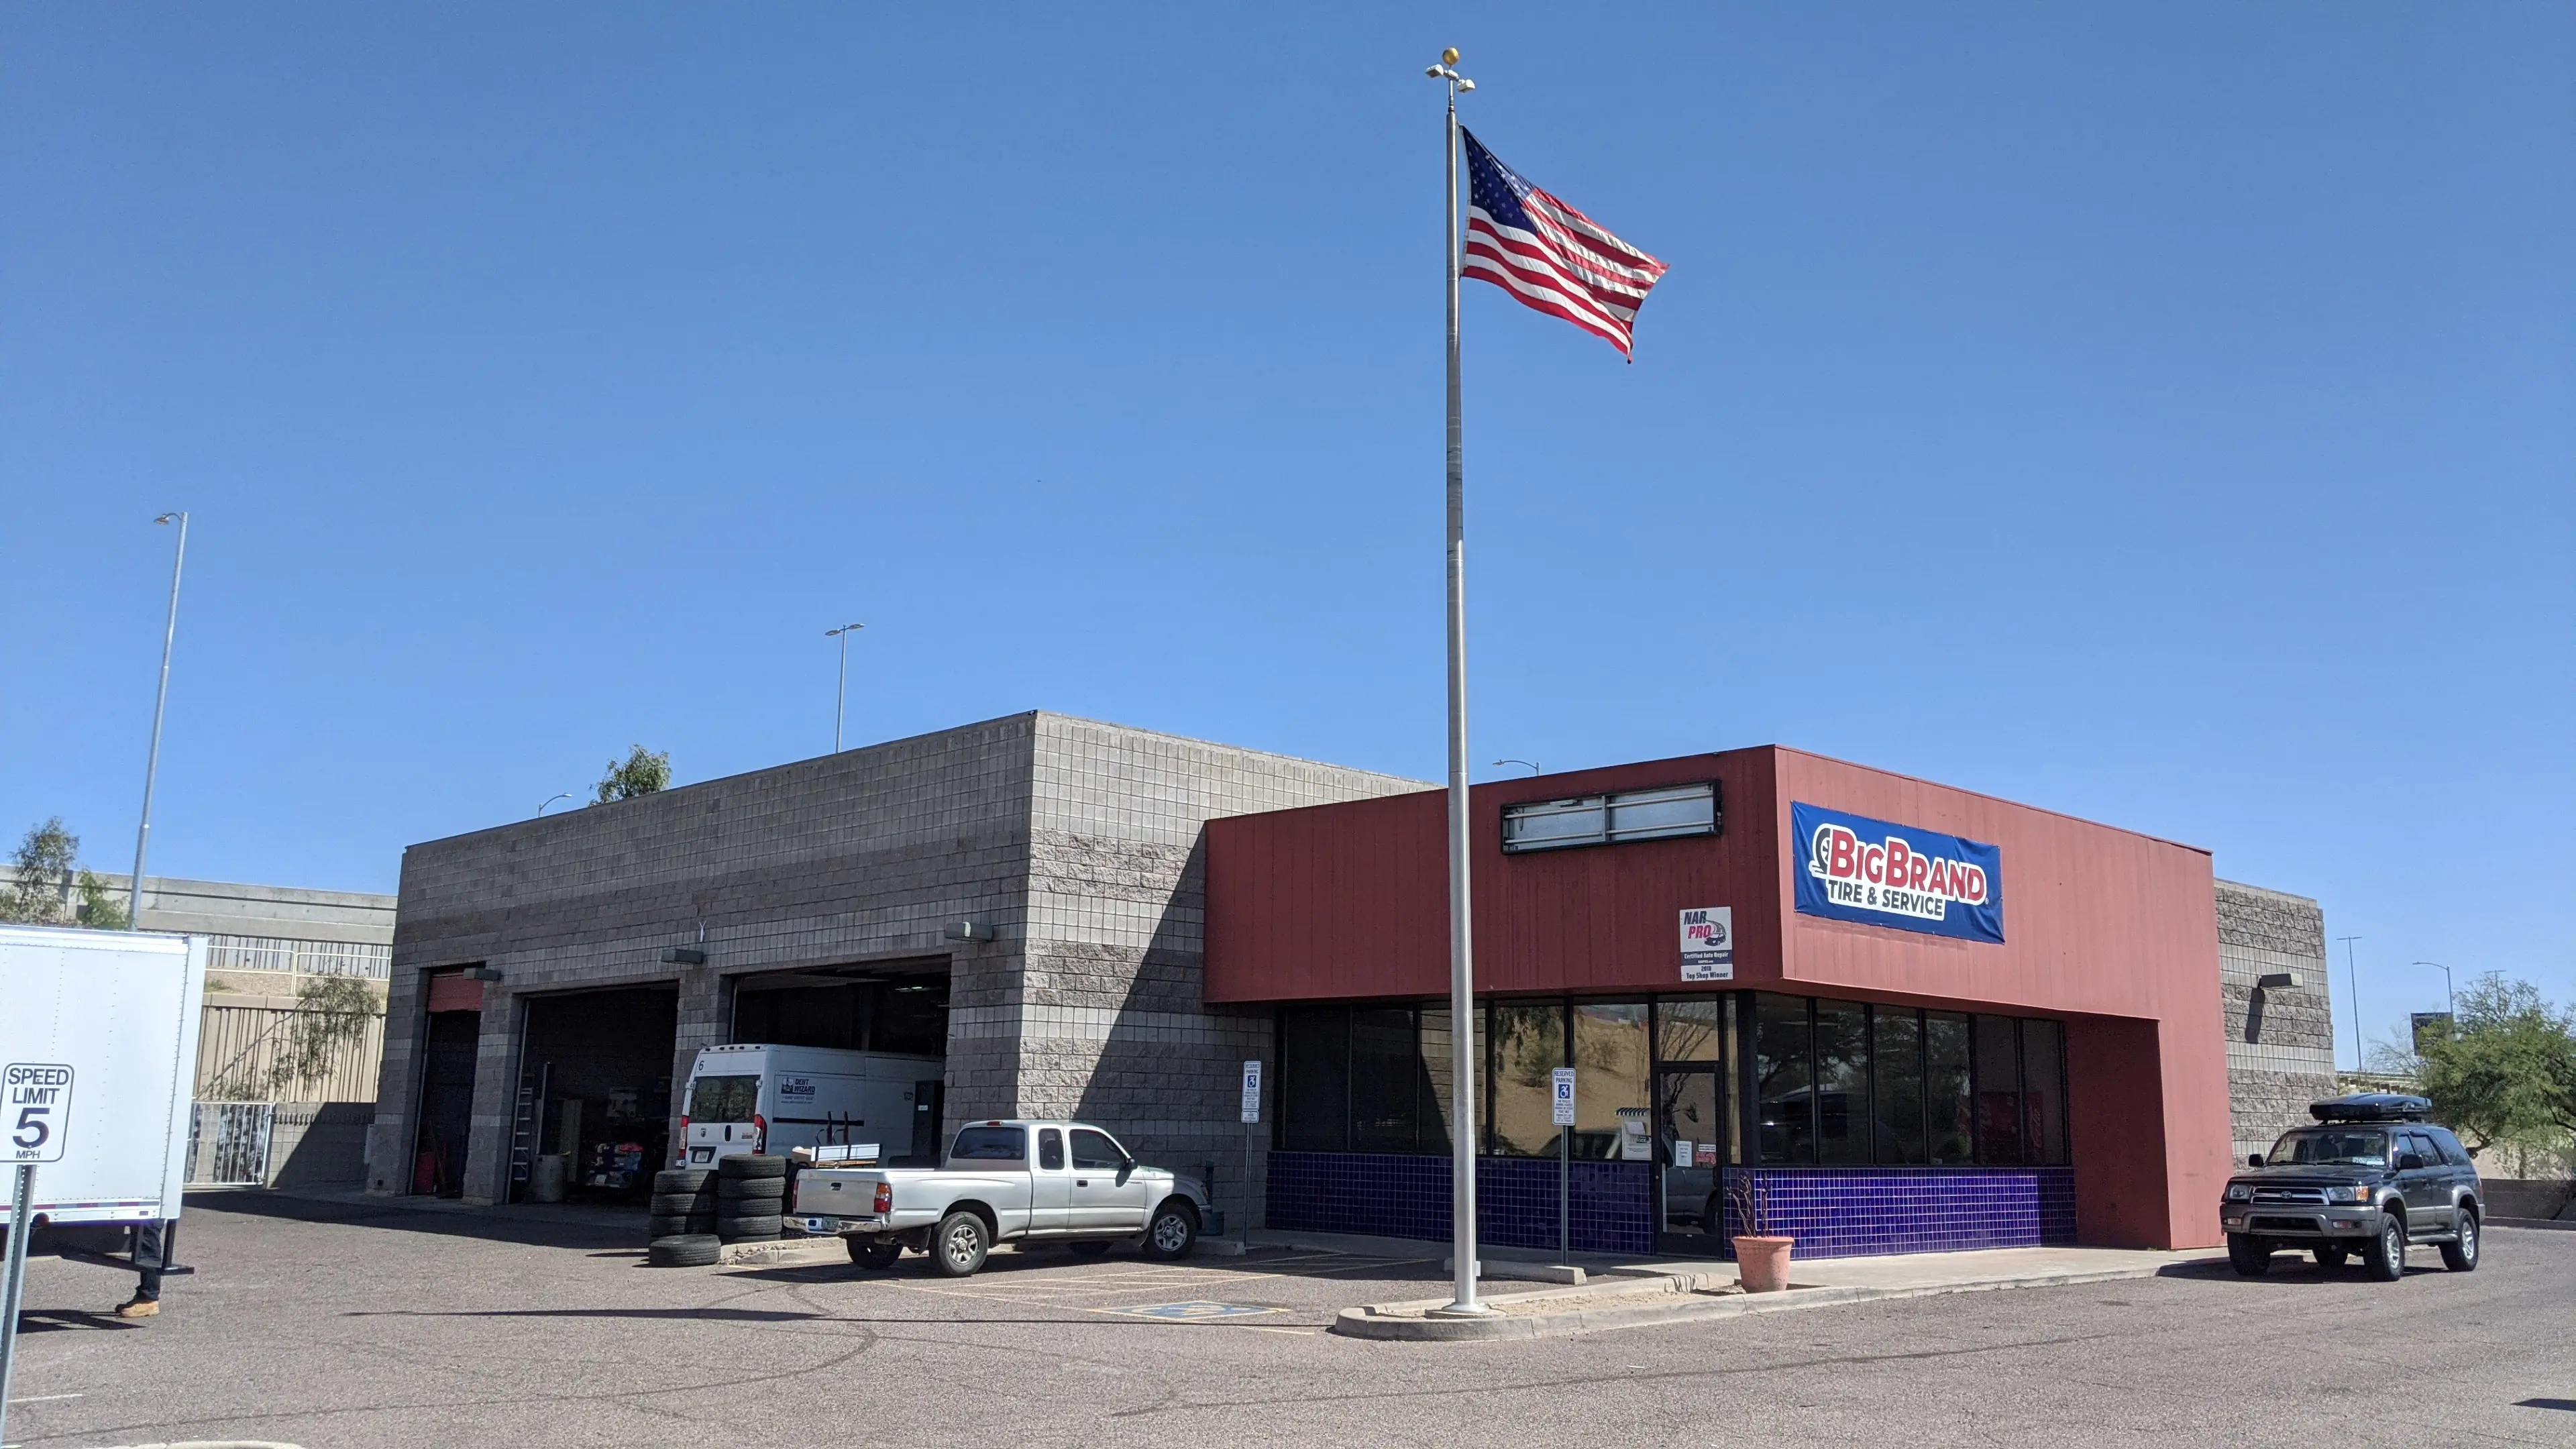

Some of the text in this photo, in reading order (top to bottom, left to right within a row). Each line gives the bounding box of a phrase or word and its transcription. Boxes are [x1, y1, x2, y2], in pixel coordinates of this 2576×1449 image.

[1828, 879, 1943, 916] TIRE & SERVICE
[1684, 911, 1707, 924] NAR
[1688, 925, 1711, 939] PRO
[1696, 972, 1709, 980] Shop
[698, 1060, 704, 1071] 6
[8, 1067, 69, 1085] SPEED
[12, 1087, 60, 1104] LIMIT
[12, 1107, 50, 1148] 5
[15, 1150, 40, 1159] MPH
